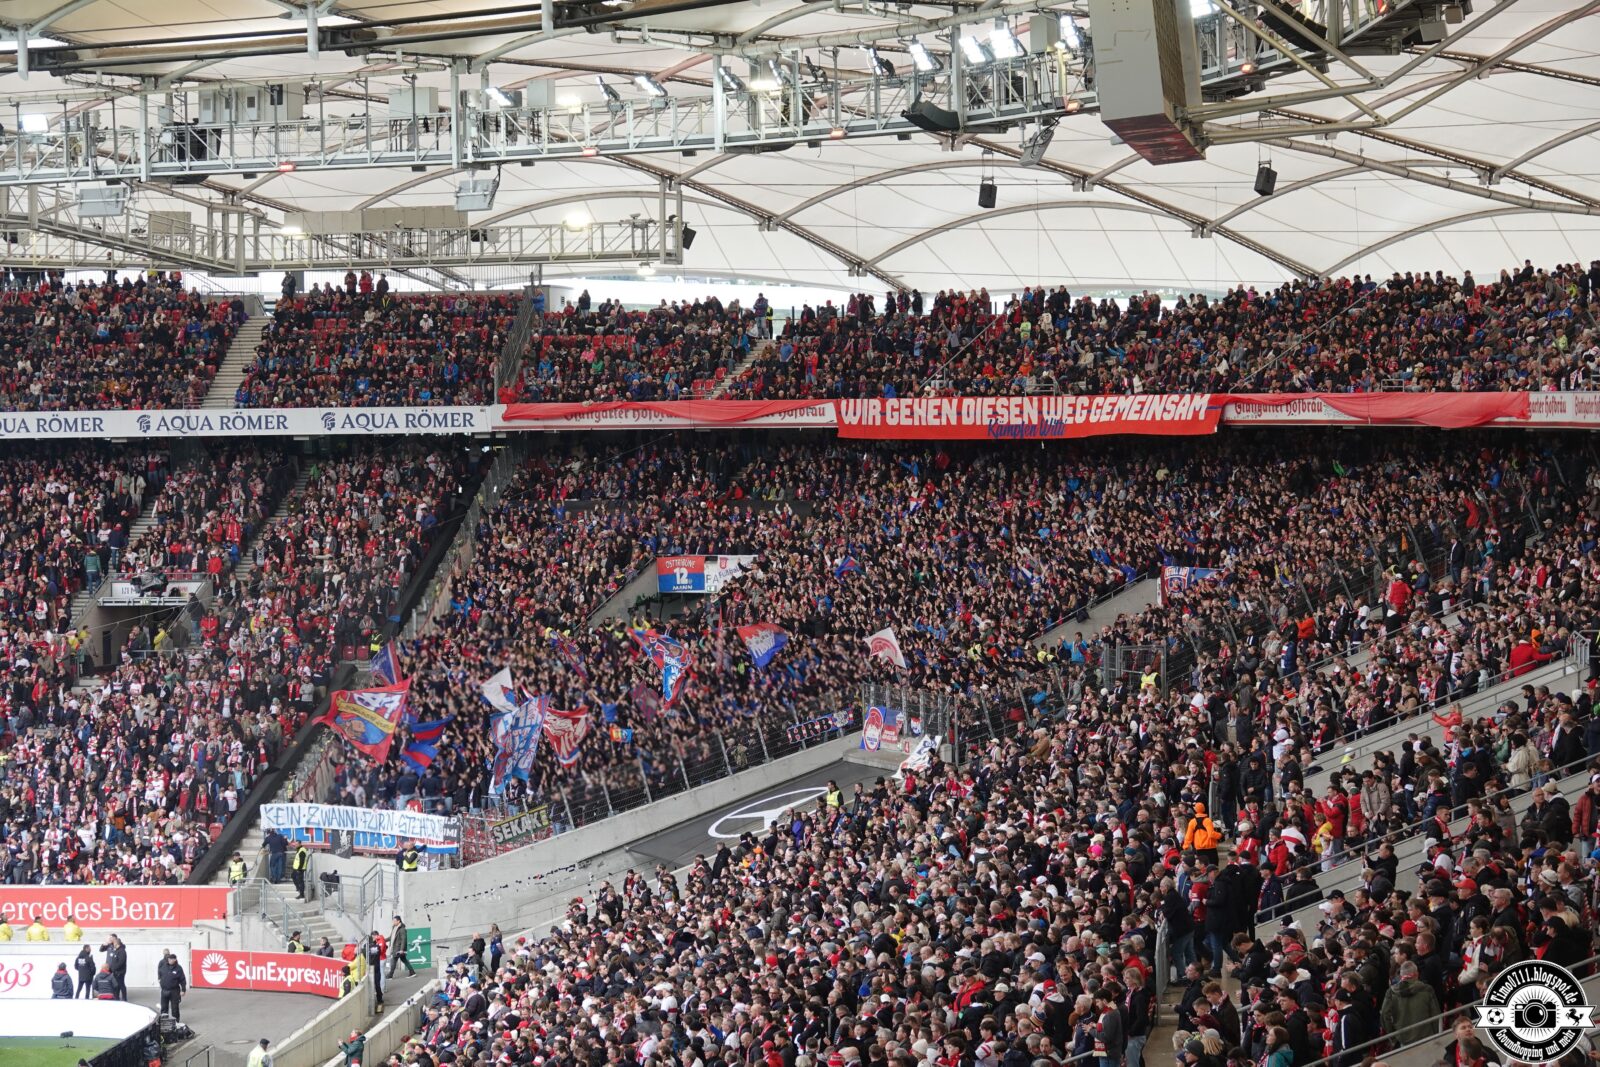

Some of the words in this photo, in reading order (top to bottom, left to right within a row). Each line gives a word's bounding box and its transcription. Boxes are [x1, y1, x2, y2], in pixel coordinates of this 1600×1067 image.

[340, 412, 399, 432] AQUA
[405, 408, 475, 428] RÖMER
[840, 398, 881, 426] WIR
[886, 397, 958, 426] GEHEN
[961, 397, 1039, 425] DIESEN
[1042, 396, 1089, 424] WEG
[1089, 393, 1211, 423] GEMEINSAM
[0, 418, 31, 437] UA
[36, 413, 105, 433] RÖMER
[156, 415, 214, 434] AQUA
[219, 411, 289, 431] RÖMER
[264, 805, 300, 826] KEIN
[306, 806, 358, 829] ZWANNI
[0, 896, 175, 921] ercedes-Benz
[235, 960, 320, 987] SunExpress
